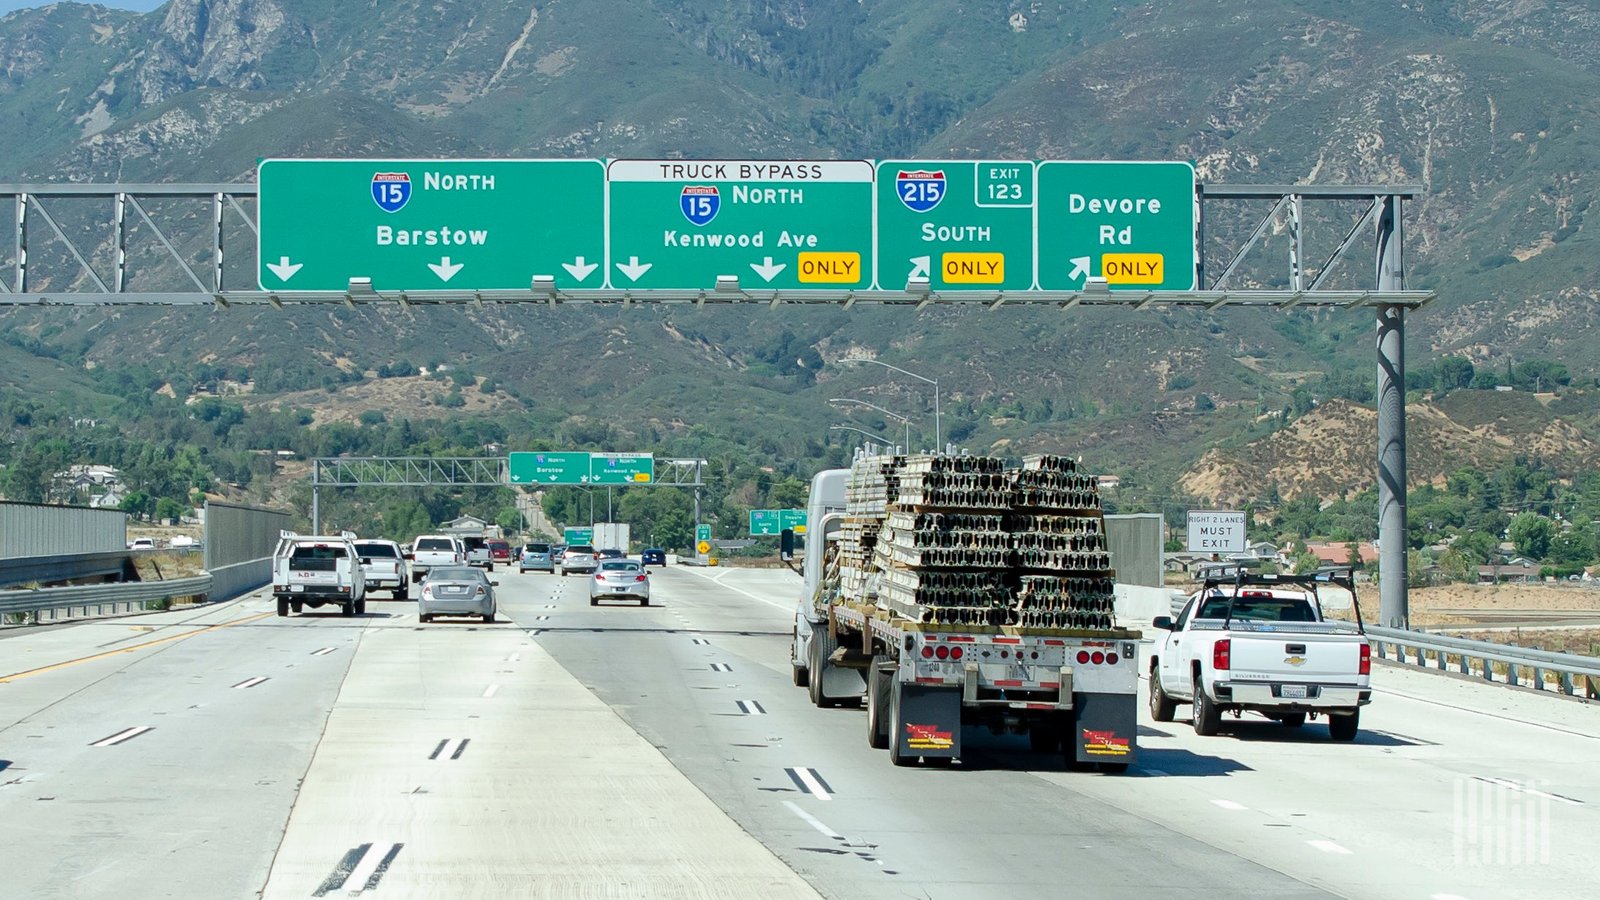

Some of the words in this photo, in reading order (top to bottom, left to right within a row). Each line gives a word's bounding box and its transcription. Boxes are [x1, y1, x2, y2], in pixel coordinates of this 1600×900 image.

[660, 164, 727, 180] TRUCK
[741, 164, 822, 180] BYPASS
[990, 168, 1020, 179] EXIT
[424, 172, 495, 190] NORTH
[380, 183, 403, 203] 15
[732, 186, 803, 204] NORTH
[903, 182, 940, 202] 215
[988, 184, 1023, 200] 123
[689, 197, 712, 217] 15
[1069, 194, 1161, 214] Devore
[376, 226, 488, 245] Barstow
[664, 230, 764, 247] Kenwood
[777, 230, 819, 247] Ave
[921, 223, 991, 242] SOUTH
[1099, 225, 1132, 245] Rd
[802, 260, 855, 275] ONLY
[946, 260, 999, 275] ONLY
[1106, 261, 1158, 275] ONLY
[1219, 516, 1245, 524] LANES
[1200, 526, 1233, 536] MUST
[1202, 539, 1230, 548] EXIT
